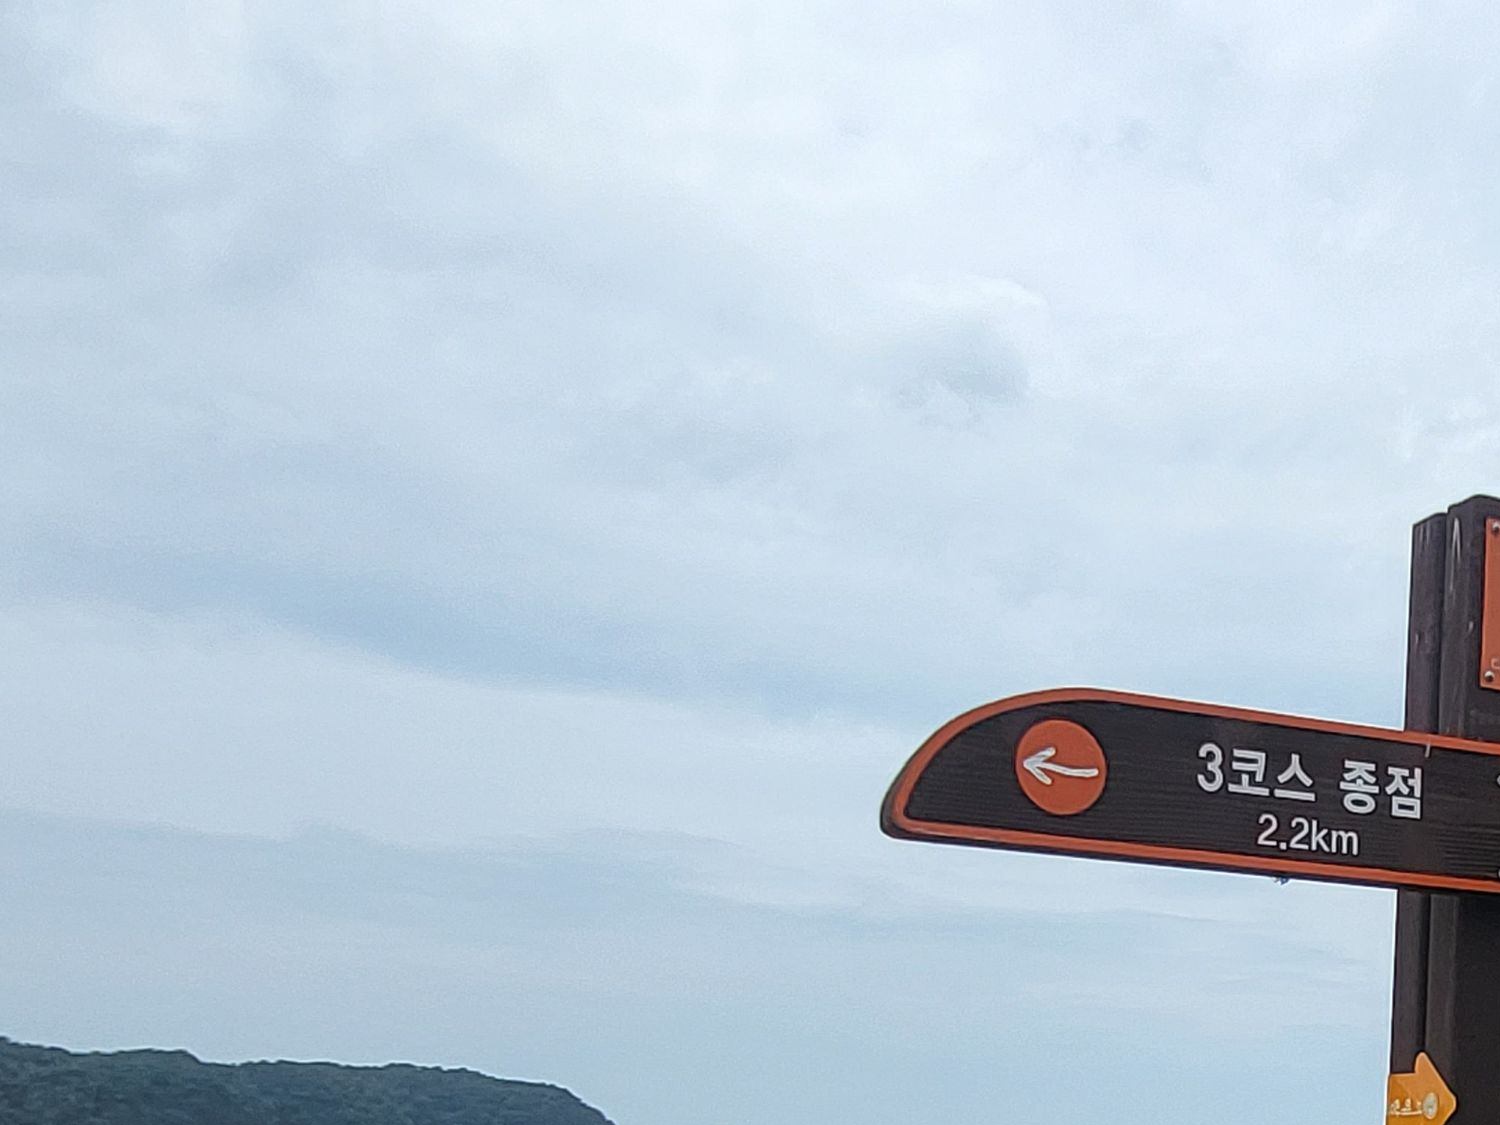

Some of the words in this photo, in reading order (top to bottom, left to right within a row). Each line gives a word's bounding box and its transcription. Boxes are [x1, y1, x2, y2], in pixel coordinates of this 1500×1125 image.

[1197, 742, 1316, 802] 3코스
[1338, 759, 1422, 820] 종점
[1257, 813, 1360, 856] 2.2km
